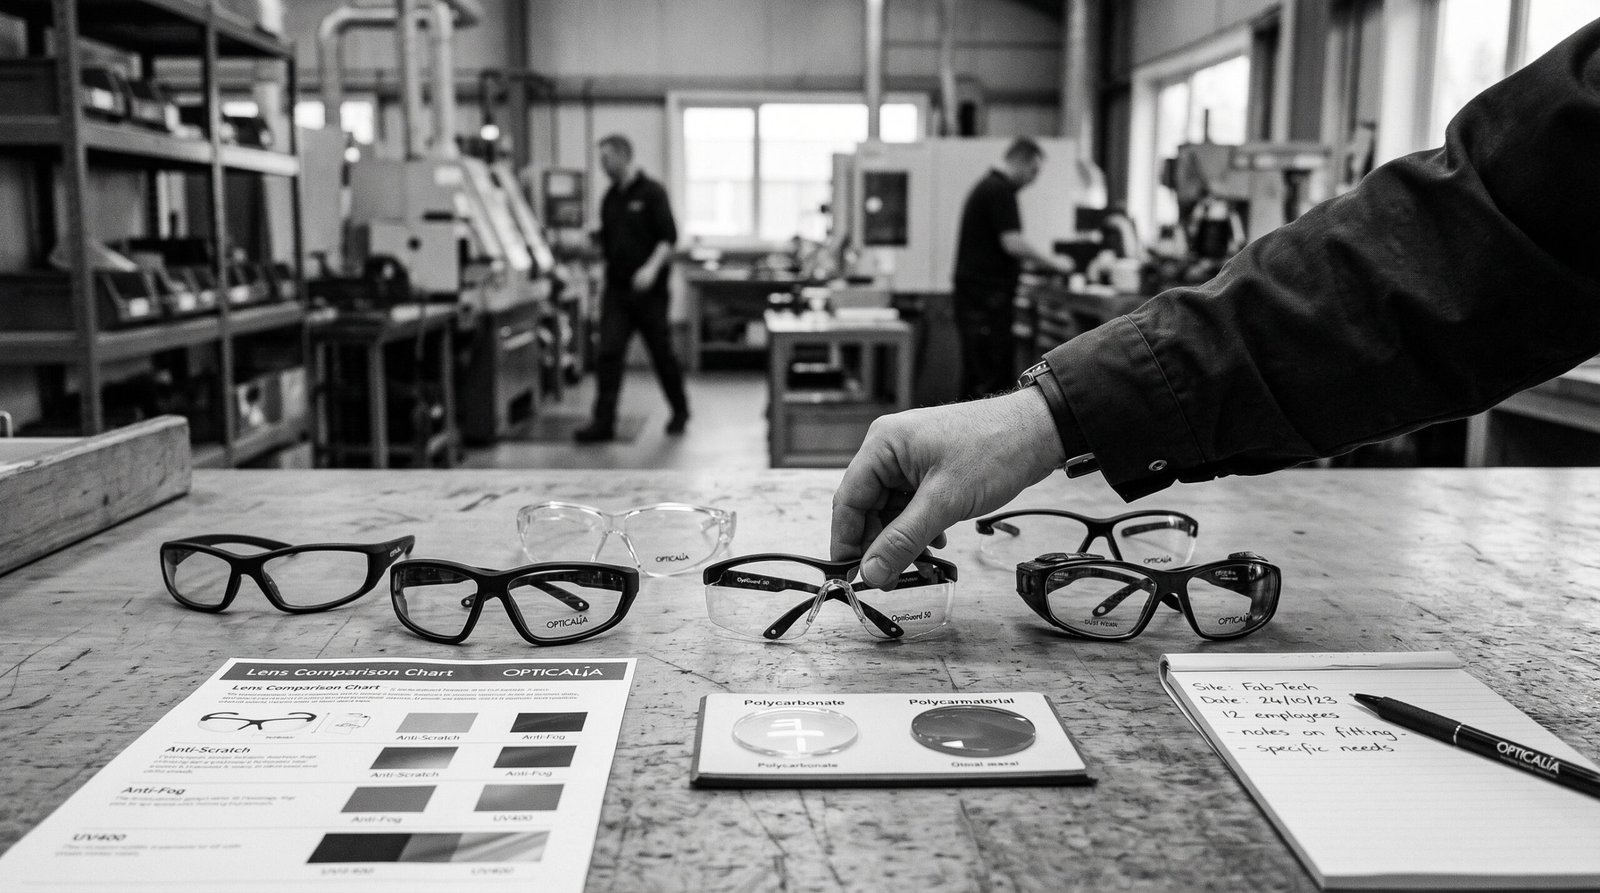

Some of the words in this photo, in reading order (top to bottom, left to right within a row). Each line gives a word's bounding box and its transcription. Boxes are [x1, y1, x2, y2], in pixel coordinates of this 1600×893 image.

[246, 668, 289, 676] Lens
[294, 668, 399, 678] Comparison
[404, 667, 453, 677] Chart
[266, 684, 342, 692] Comparison
[744, 699, 846, 707] Polycarbonate
[1258, 694, 1338, 705] 24/10/23
[1222, 711, 1245, 719] 12
[1255, 711, 1340, 723] employees
[1241, 727, 1290, 736] notes
[164, 745, 252, 754] Anti-Scratch
[1256, 743, 1329, 755] specific
[1340, 743, 1395, 752] needs
[120, 786, 187, 795] Anti-Fog
